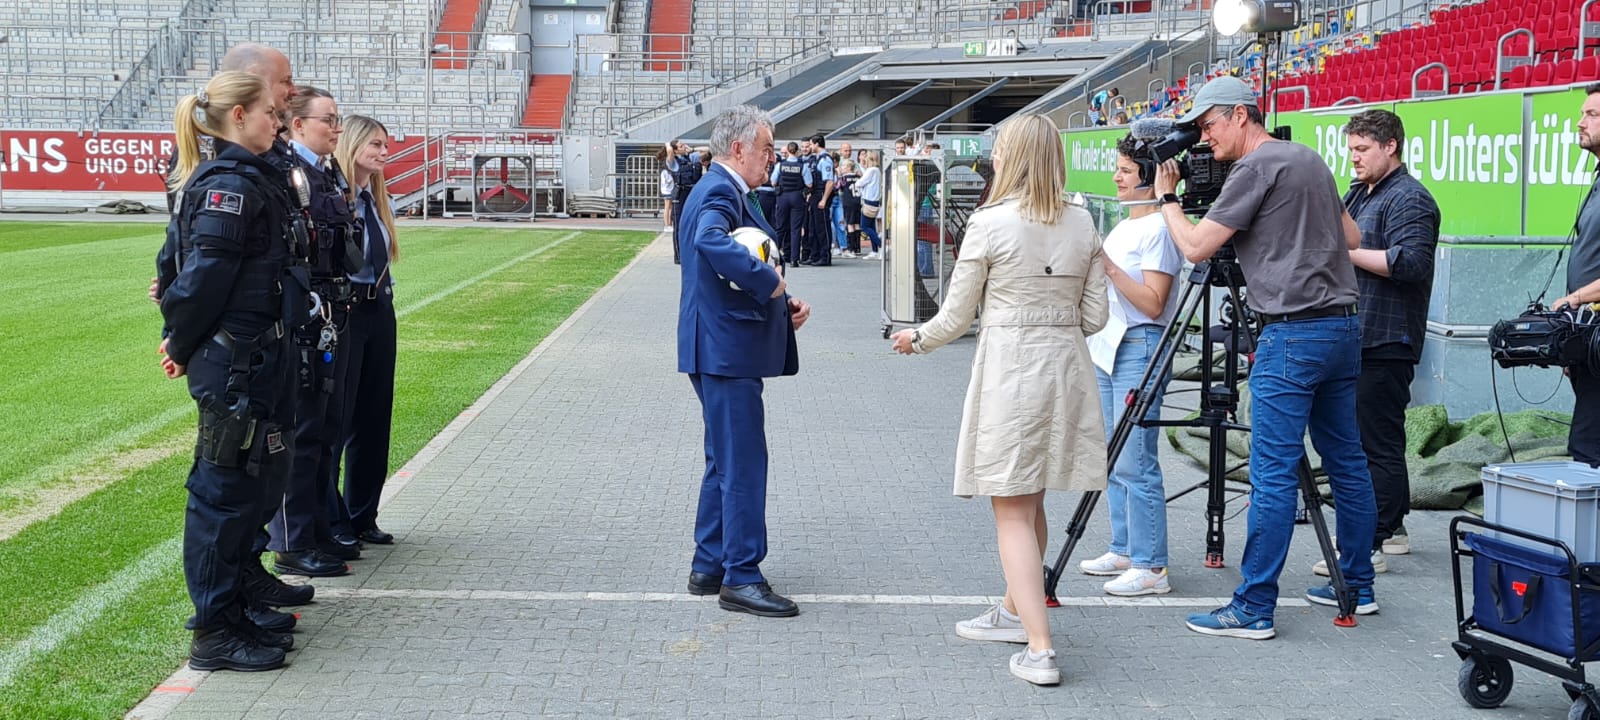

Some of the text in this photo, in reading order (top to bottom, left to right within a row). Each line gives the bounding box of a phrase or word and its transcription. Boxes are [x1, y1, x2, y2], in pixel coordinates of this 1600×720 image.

[85, 138, 153, 155] GEGEN
[1315, 124, 1358, 178] 189
[1430, 113, 1600, 185] Unterstütz
[85, 158, 171, 174] UND DIS
[781, 165, 801, 174] POLIZEI
